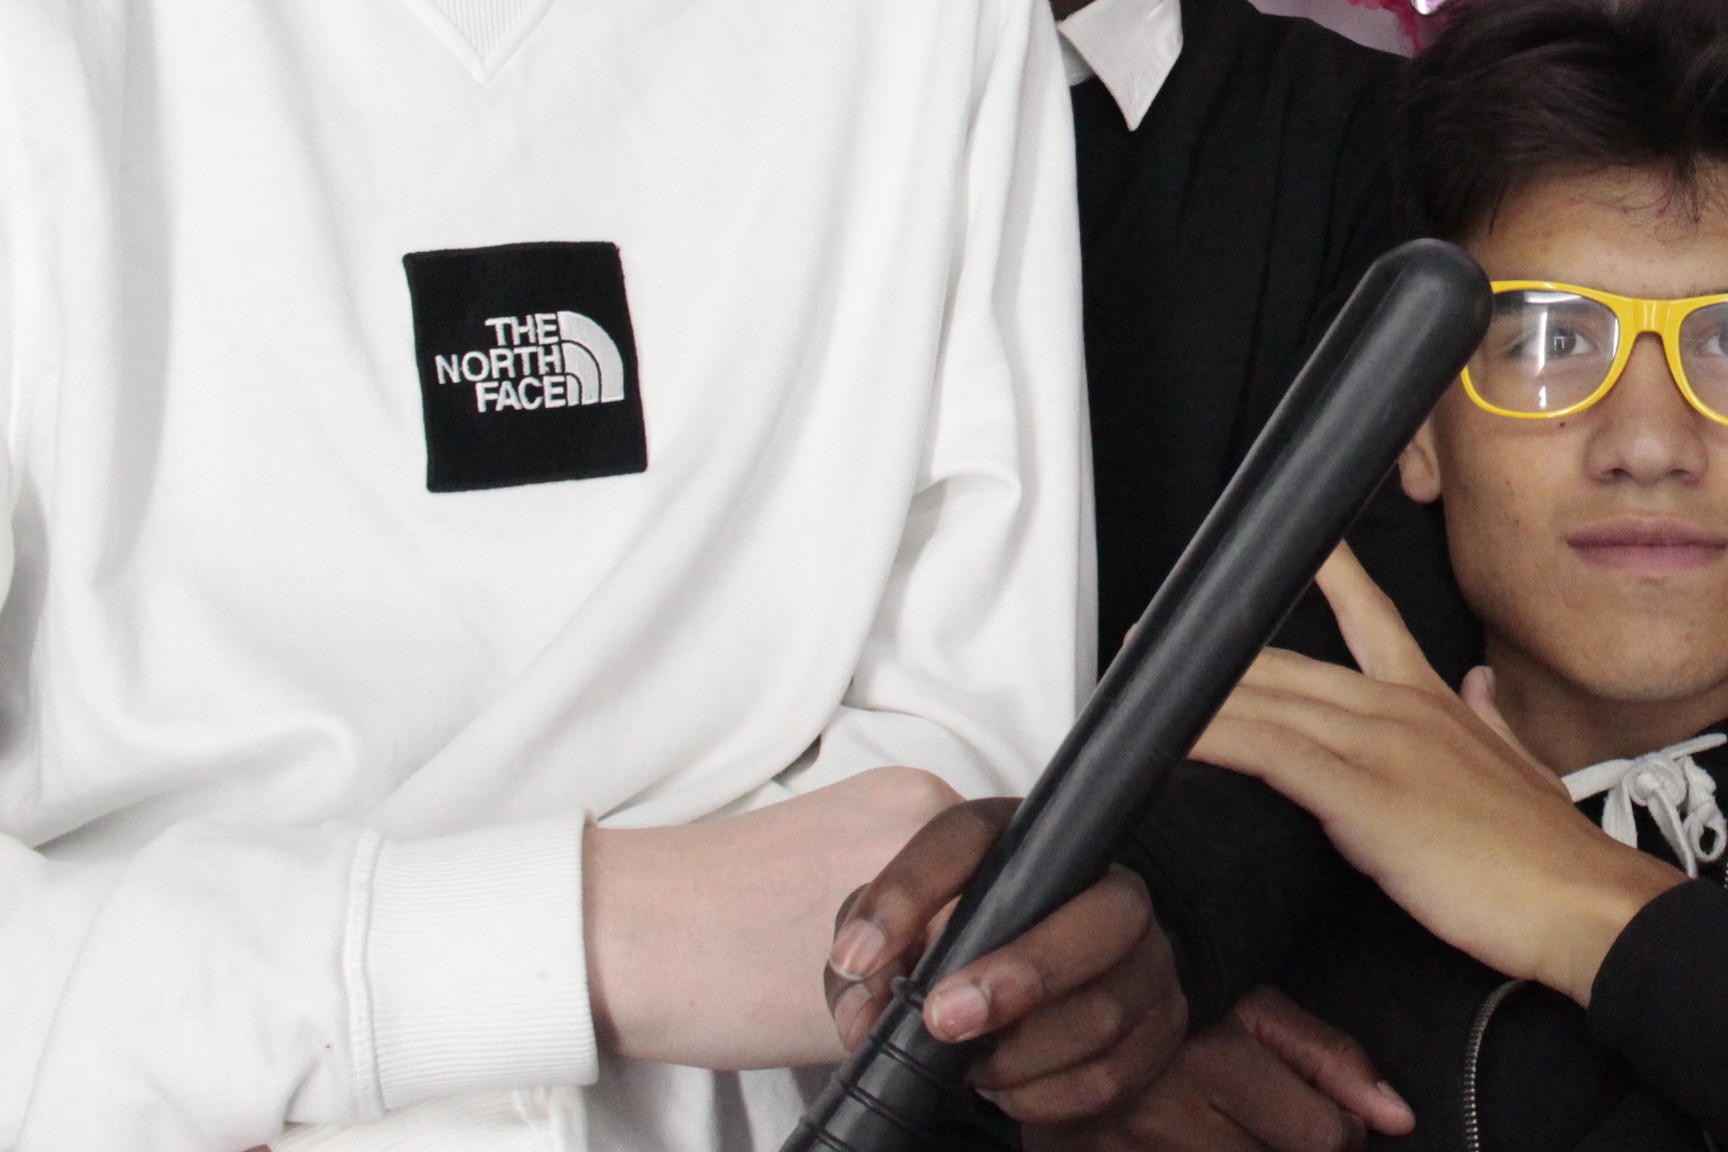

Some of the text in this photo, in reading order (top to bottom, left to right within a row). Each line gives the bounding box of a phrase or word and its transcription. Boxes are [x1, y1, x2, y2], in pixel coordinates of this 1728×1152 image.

[485, 313, 559, 346] THE
[434, 345, 563, 384] NORTH
[475, 375, 567, 413] FACE
